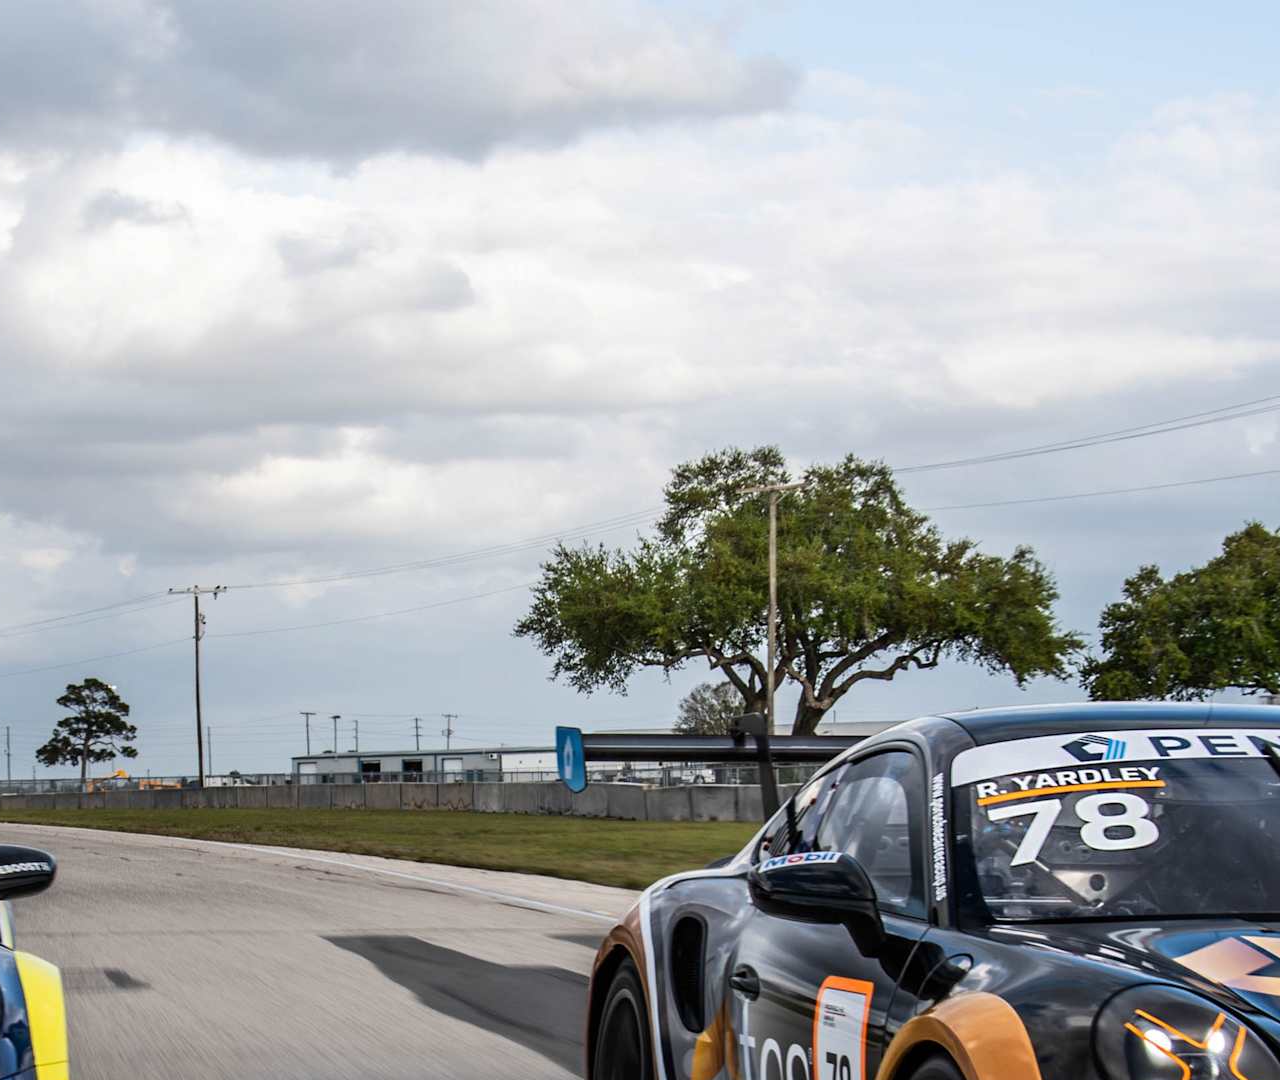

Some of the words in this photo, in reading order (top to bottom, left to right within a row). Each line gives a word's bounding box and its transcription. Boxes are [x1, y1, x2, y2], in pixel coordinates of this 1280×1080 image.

[976, 780, 1009, 798] R.
[1014, 767, 1161, 794] YARDLEY
[986, 792, 1160, 867] 78
[765, 853, 836, 868] Mobil
